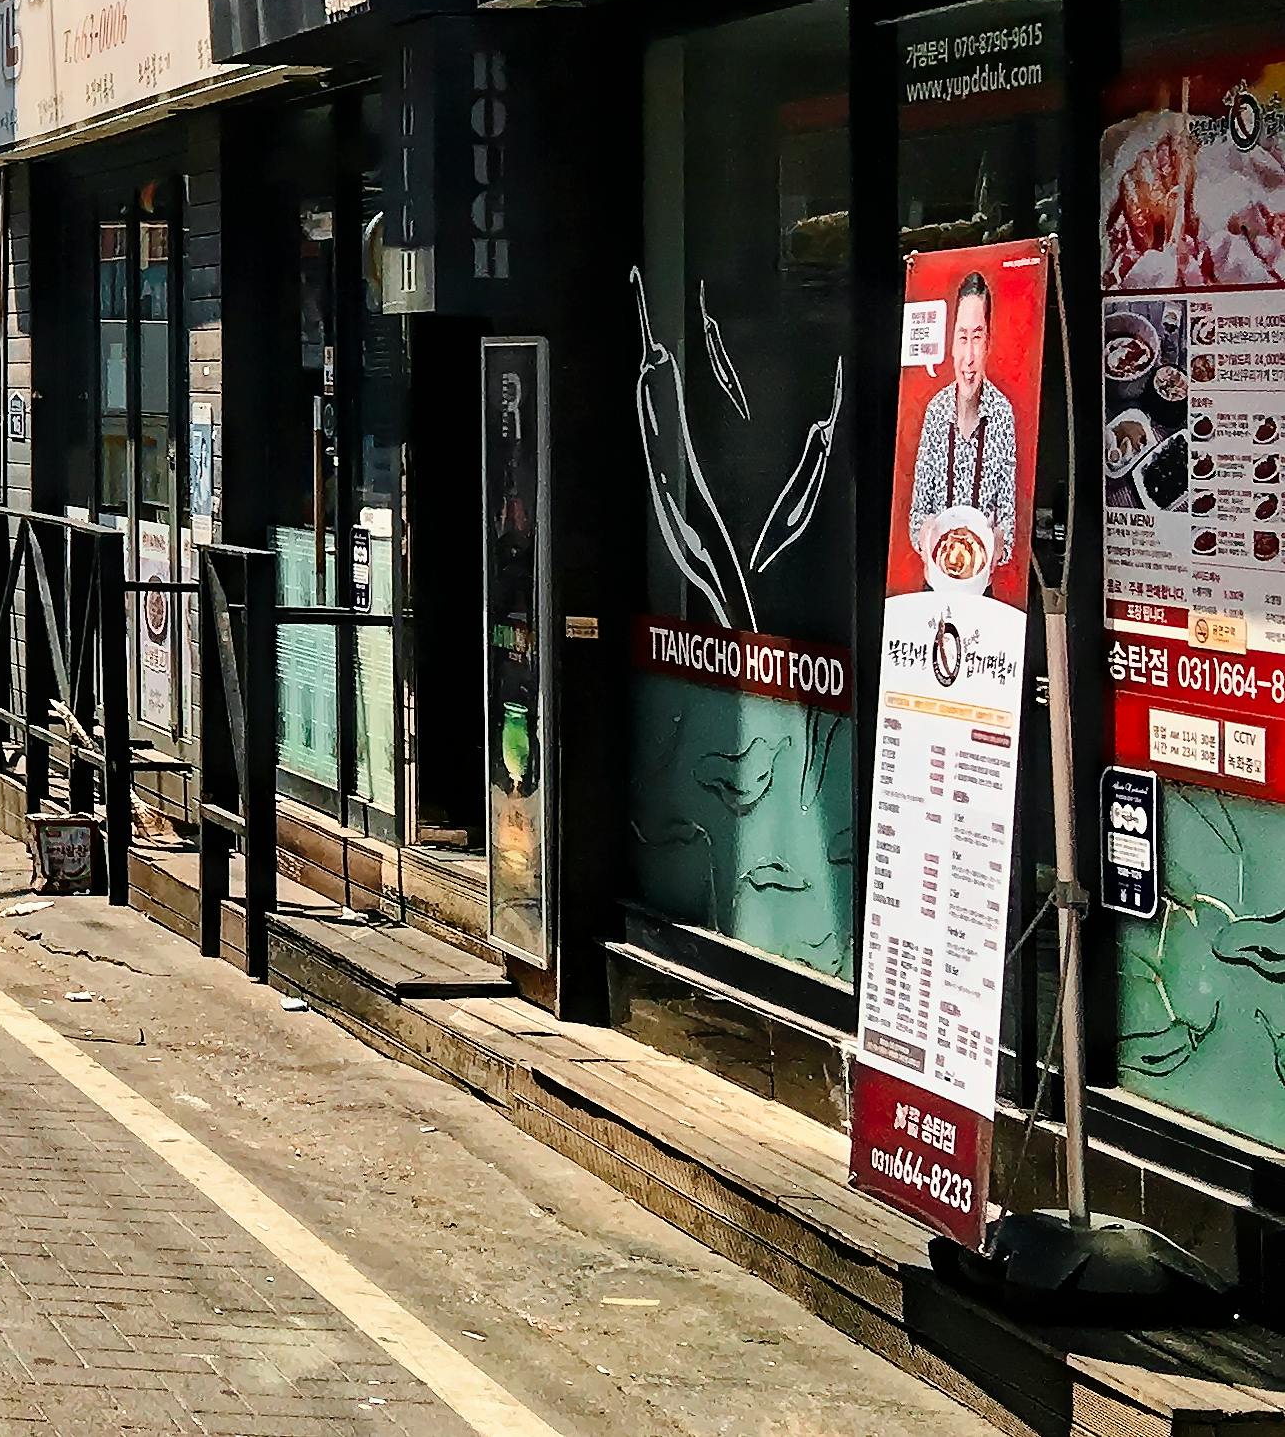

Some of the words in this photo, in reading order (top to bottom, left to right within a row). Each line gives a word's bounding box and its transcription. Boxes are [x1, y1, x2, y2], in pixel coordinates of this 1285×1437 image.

[905, 37, 949, 69] 가맹문의
[953, 22, 1044, 60] 070-8796-9615
[906, 62, 1043, 102] www.yupdduk.com
[745, 644, 785, 686] HOT
[788, 651, 844, 696] FOOD
[1108, 640, 1170, 688] 송탄점
[1232, 729, 1258, 747] CCTV
